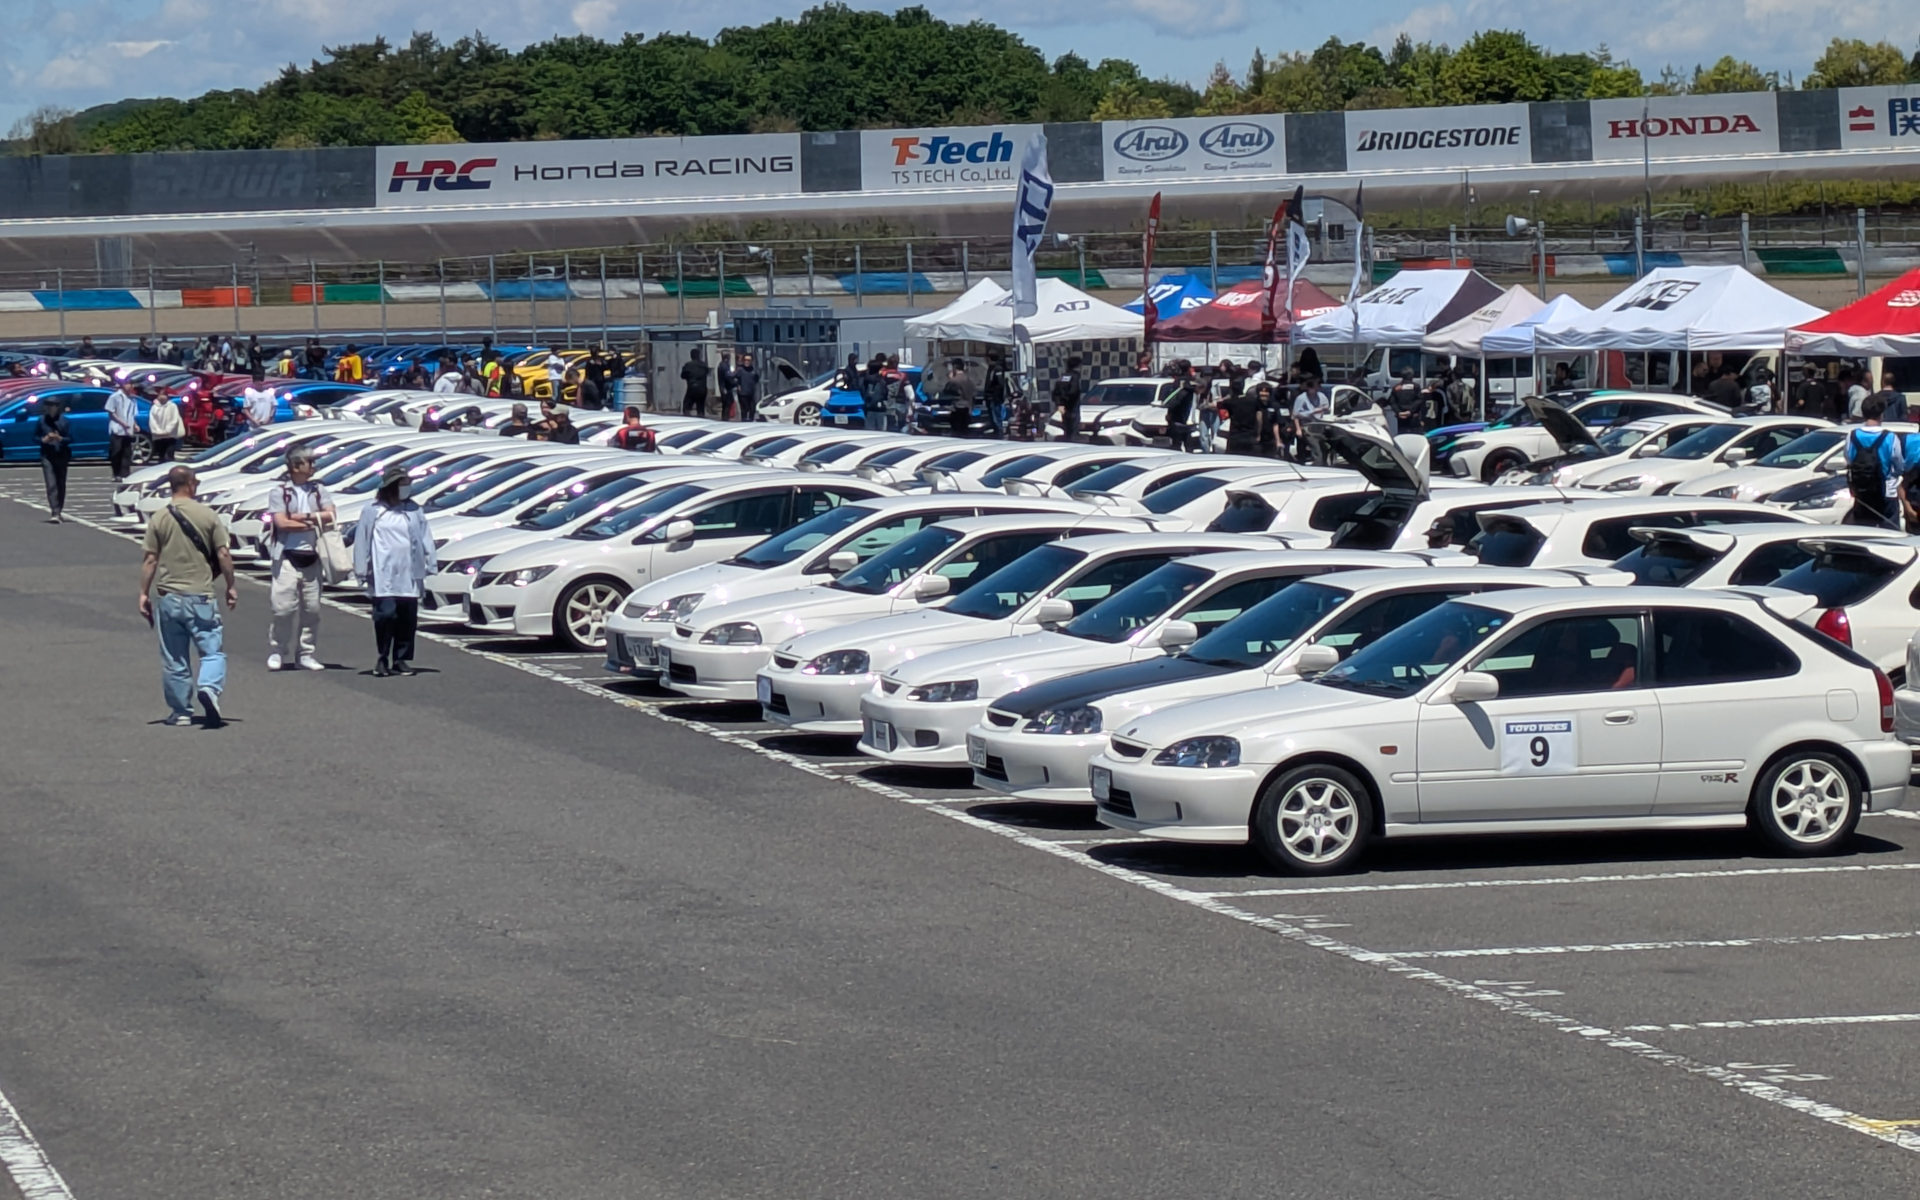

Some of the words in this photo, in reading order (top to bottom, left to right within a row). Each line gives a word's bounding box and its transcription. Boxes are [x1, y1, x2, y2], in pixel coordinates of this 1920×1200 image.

[1205, 127, 1266, 148] Arai
[1608, 114, 1761, 139] HONDA
[1120, 131, 1181, 152] Arai
[1356, 126, 1521, 151] BRIDGESTONE
[388, 158, 498, 193] HRC
[514, 160, 645, 181] Honda
[655, 156, 793, 177] RACING
[892, 170, 910, 184] TS
[914, 169, 955, 183] TECH
[1054, 300, 1091, 313] ATJ
[1508, 723, 1537, 733] TOYO
[1538, 722, 1569, 732] TIRES
[1530, 736, 1550, 767] 9
